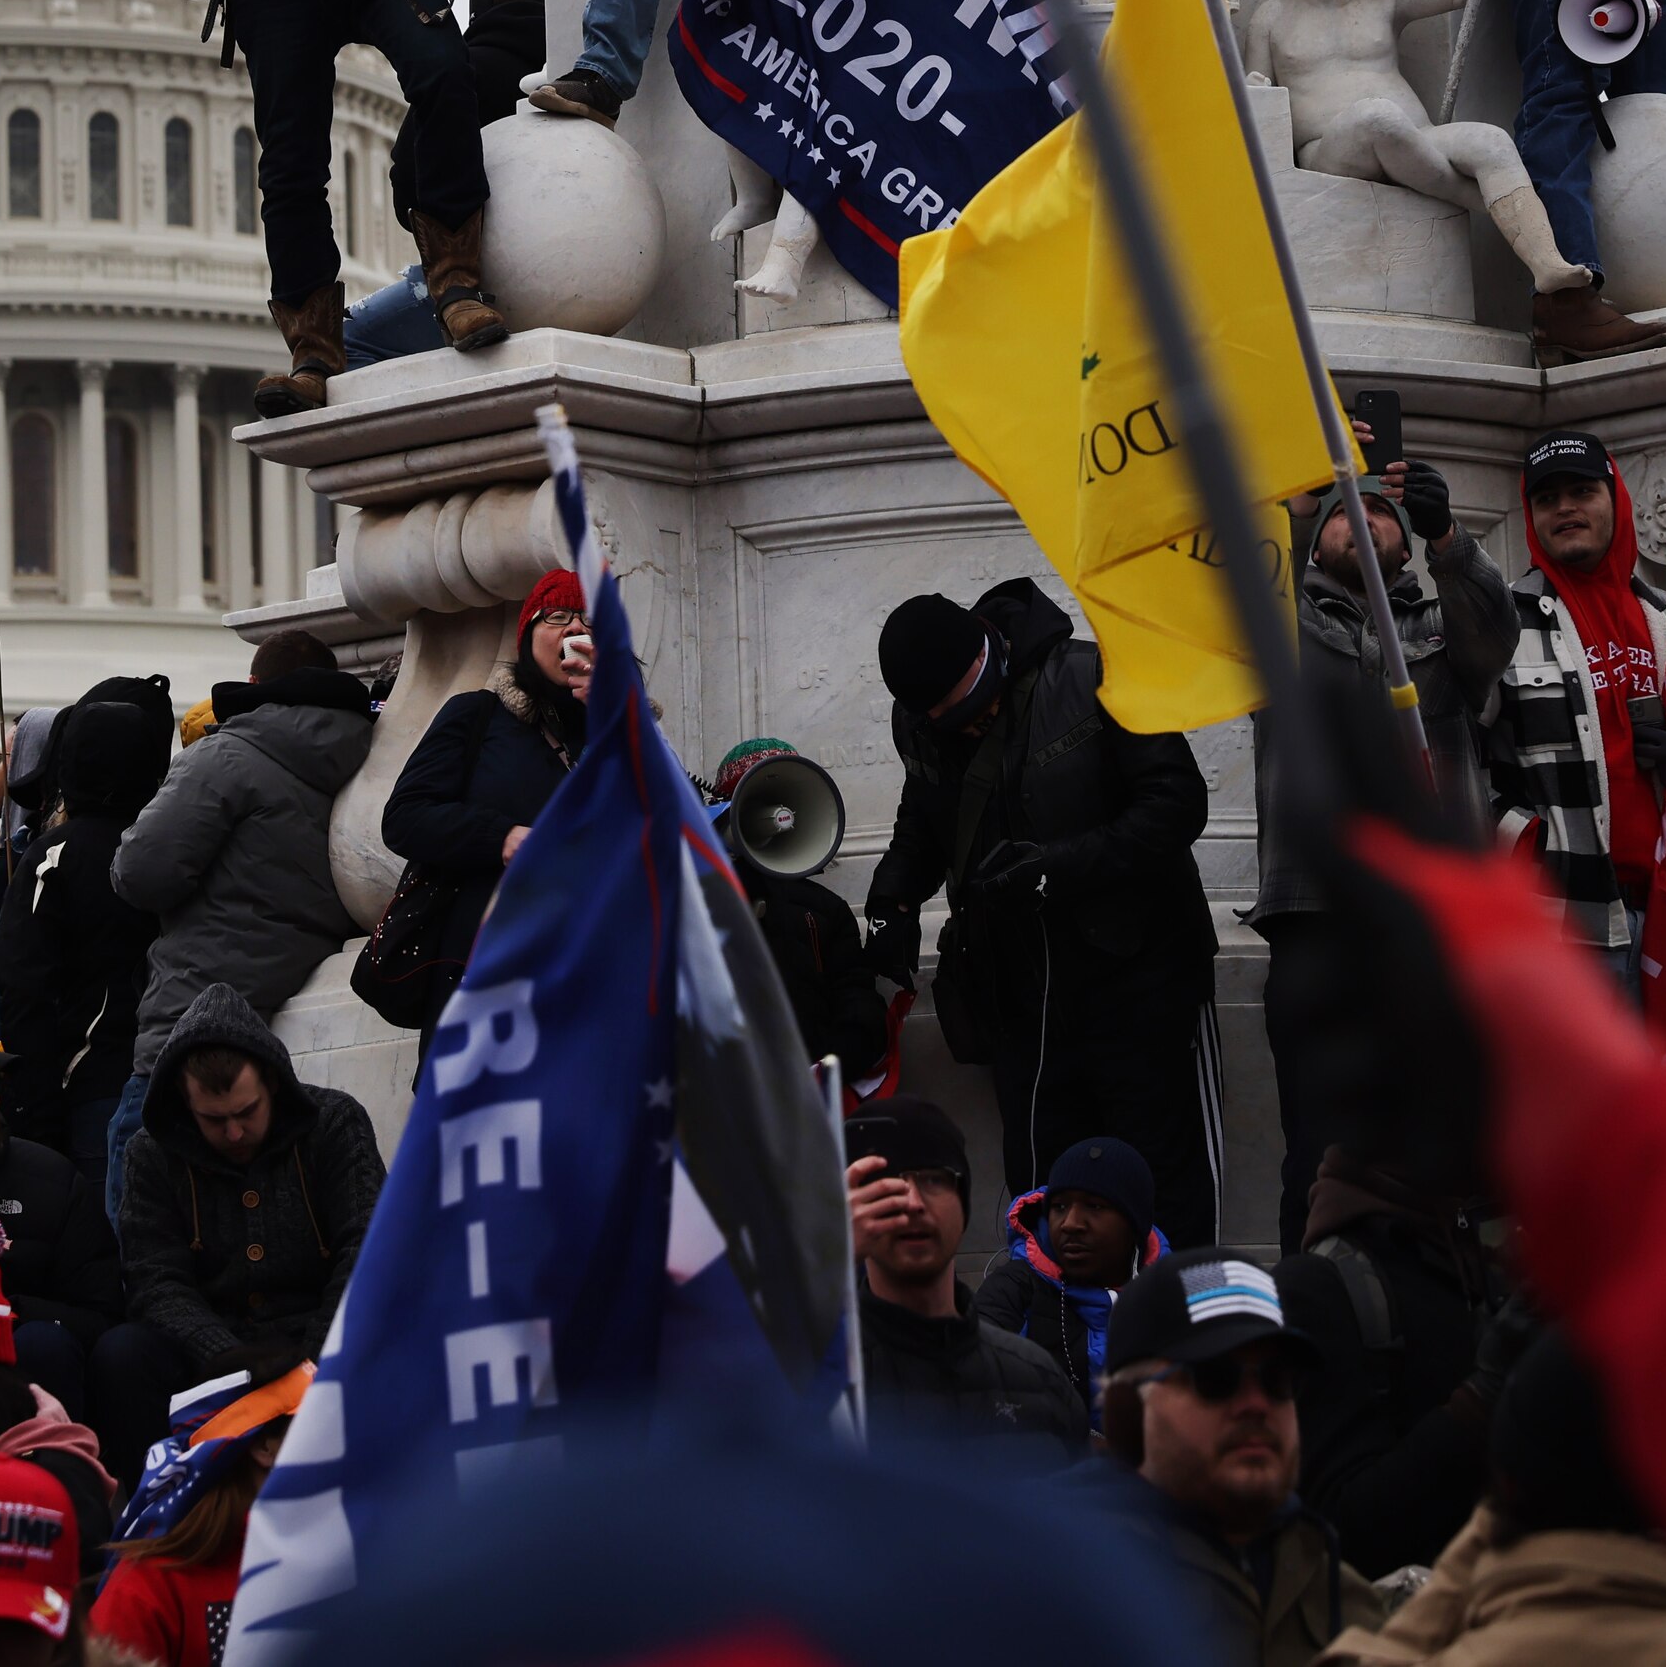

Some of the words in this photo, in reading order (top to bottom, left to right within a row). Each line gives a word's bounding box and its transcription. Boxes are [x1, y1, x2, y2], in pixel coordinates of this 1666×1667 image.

[721, 23, 878, 179] AMERICA
[1529, 443, 1549, 461] MAKE
[1550, 439, 1588, 449] AMERICA
[1531, 449, 1556, 466] GREAT
[1558, 447, 1586, 455] AGAIN
